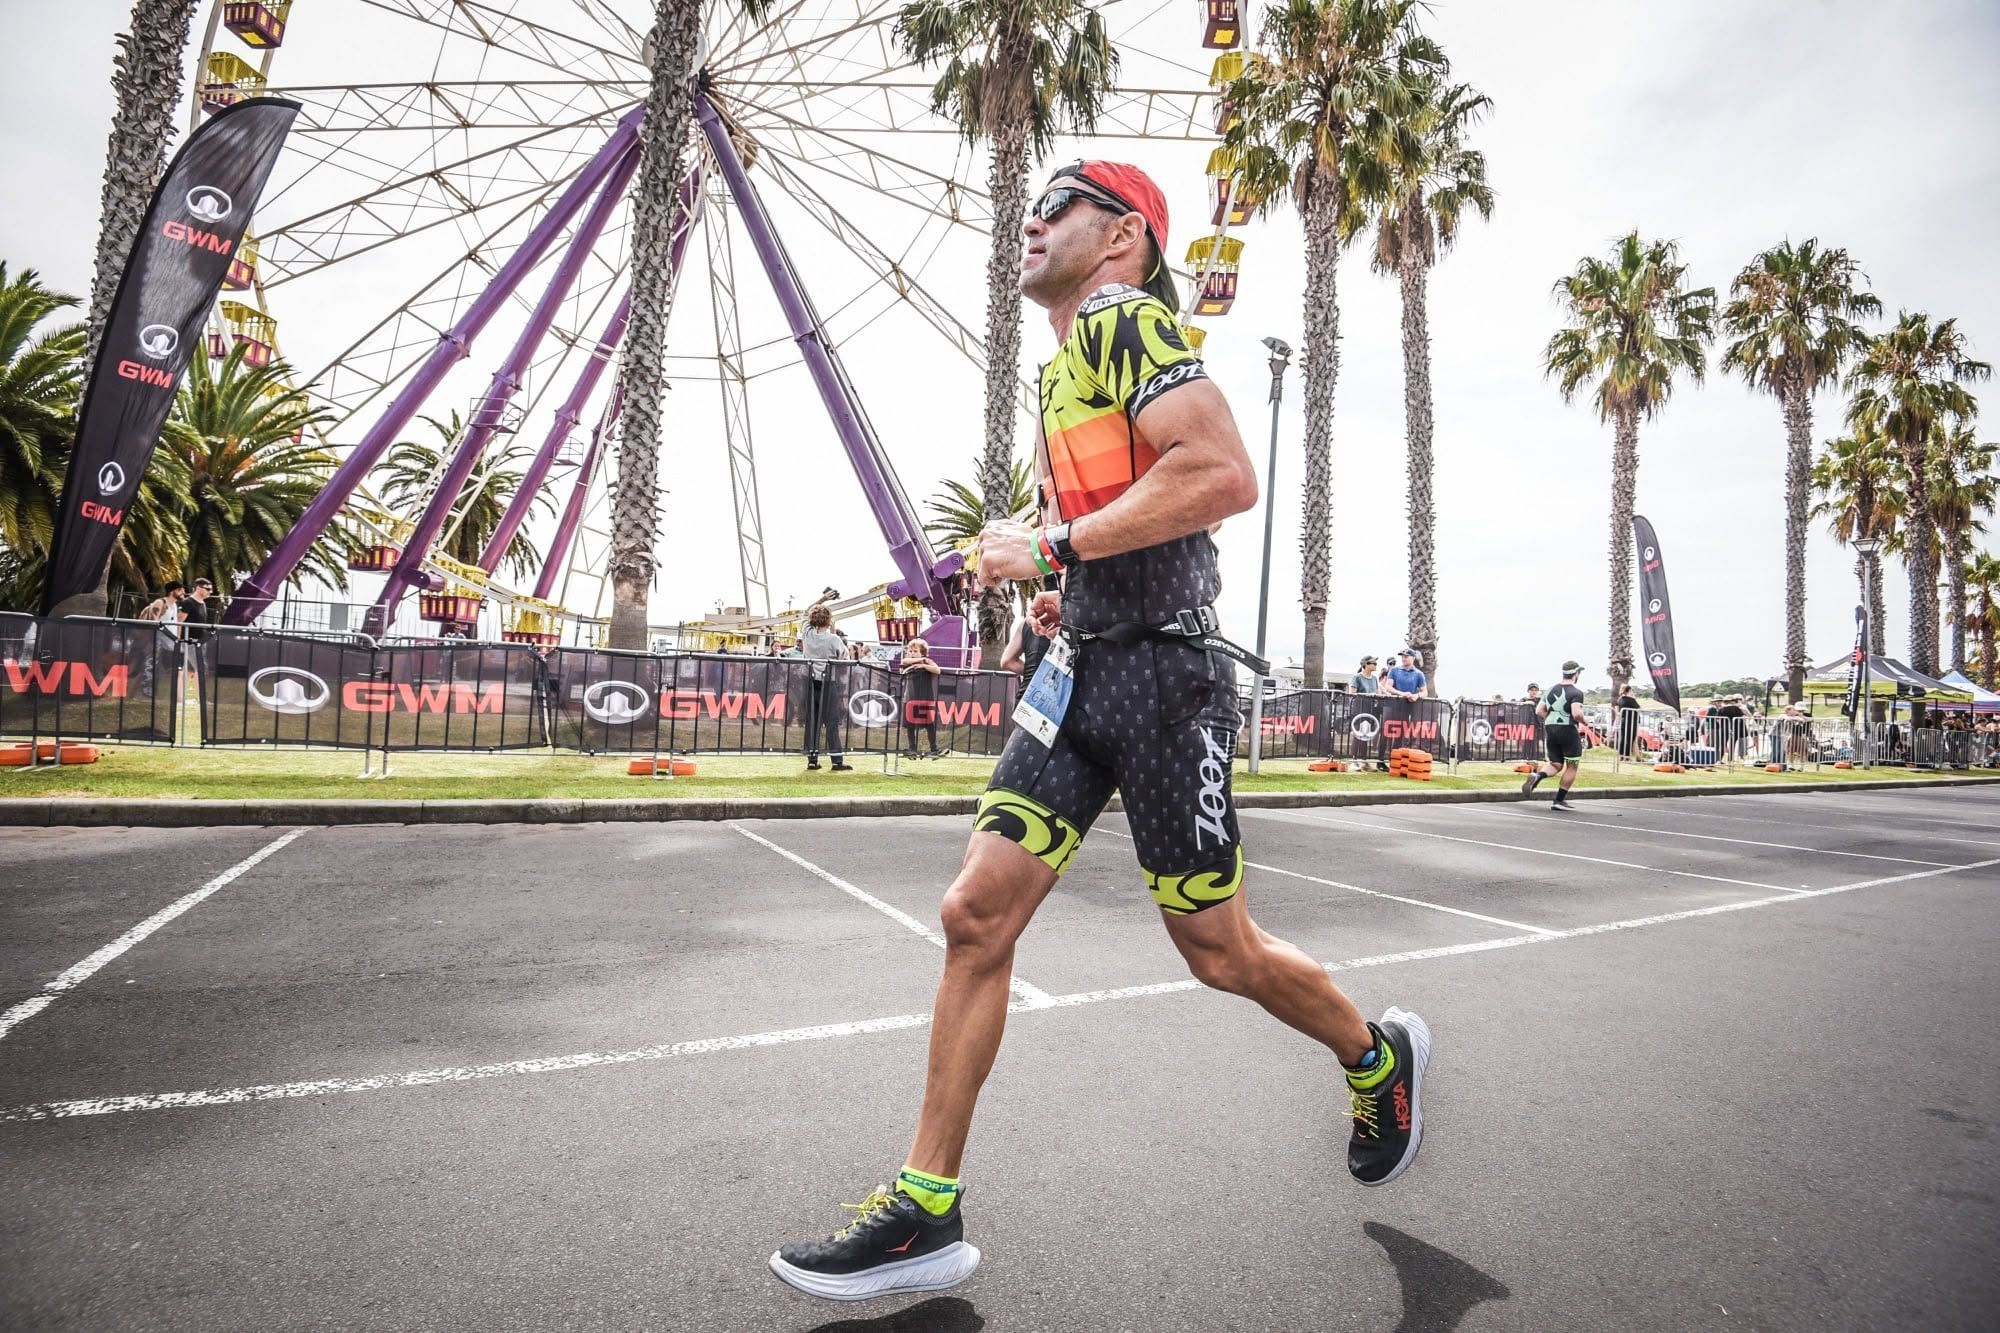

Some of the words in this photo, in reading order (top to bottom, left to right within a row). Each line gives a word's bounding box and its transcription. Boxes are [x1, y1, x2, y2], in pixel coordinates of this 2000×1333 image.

[162, 220, 232, 255] GWM
[117, 359, 174, 388] GWM
[81, 500, 123, 526] GWM
[342, 681, 505, 714] GWM
[659, 690, 787, 721] GWM
[905, 700, 1000, 726] GWM
[1383, 720, 1437, 739] GWM
[1493, 724, 1536, 741] GWM
[1393, 1081, 1410, 1130] HOKA
